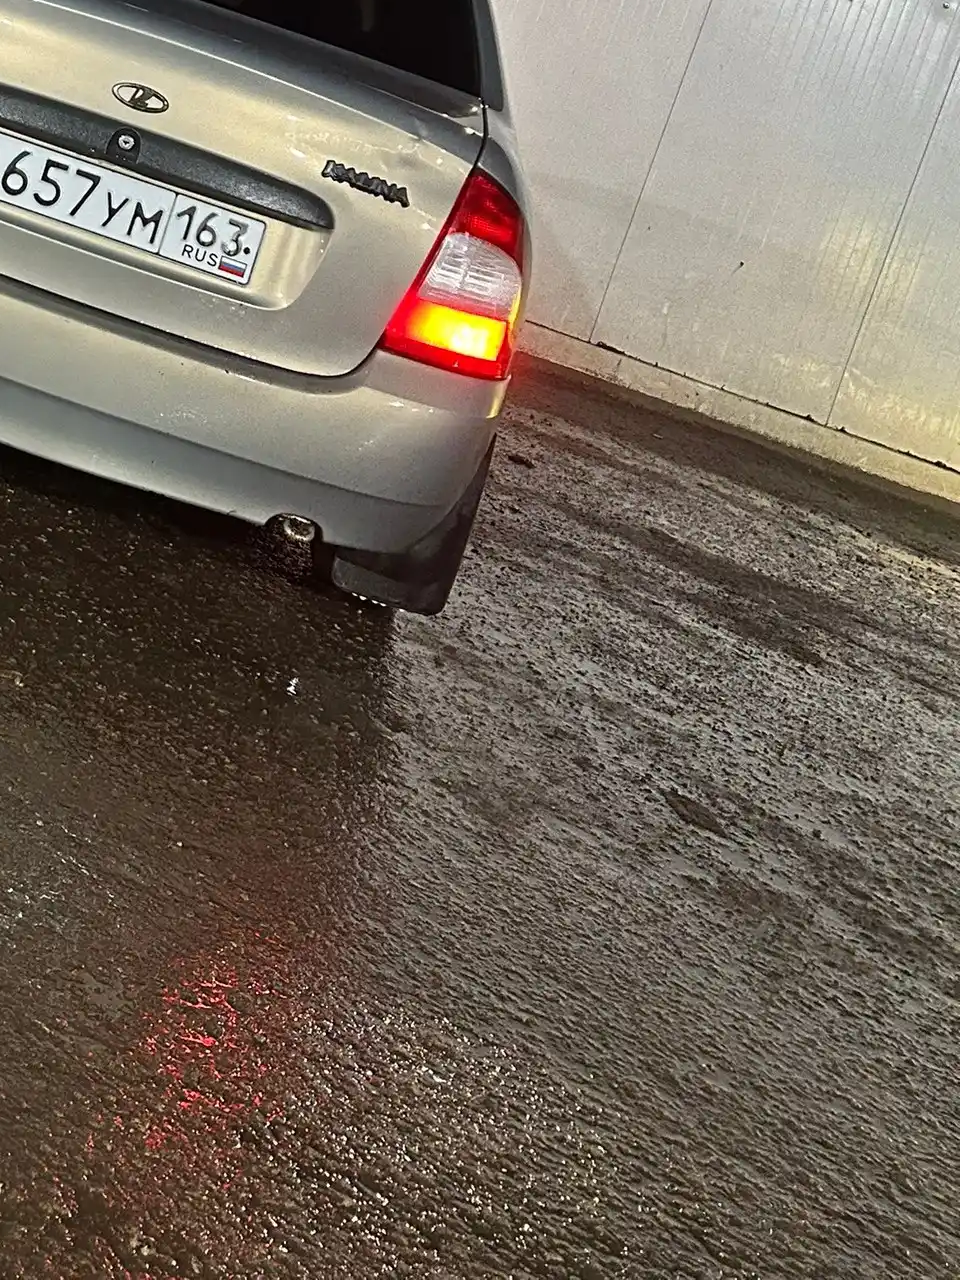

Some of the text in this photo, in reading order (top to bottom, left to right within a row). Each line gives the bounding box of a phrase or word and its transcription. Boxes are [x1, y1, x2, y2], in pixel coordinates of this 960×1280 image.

[321, 159, 410, 208] KALINA
[176, 205, 249, 257] 163
[181, 243, 219, 268] RUS
